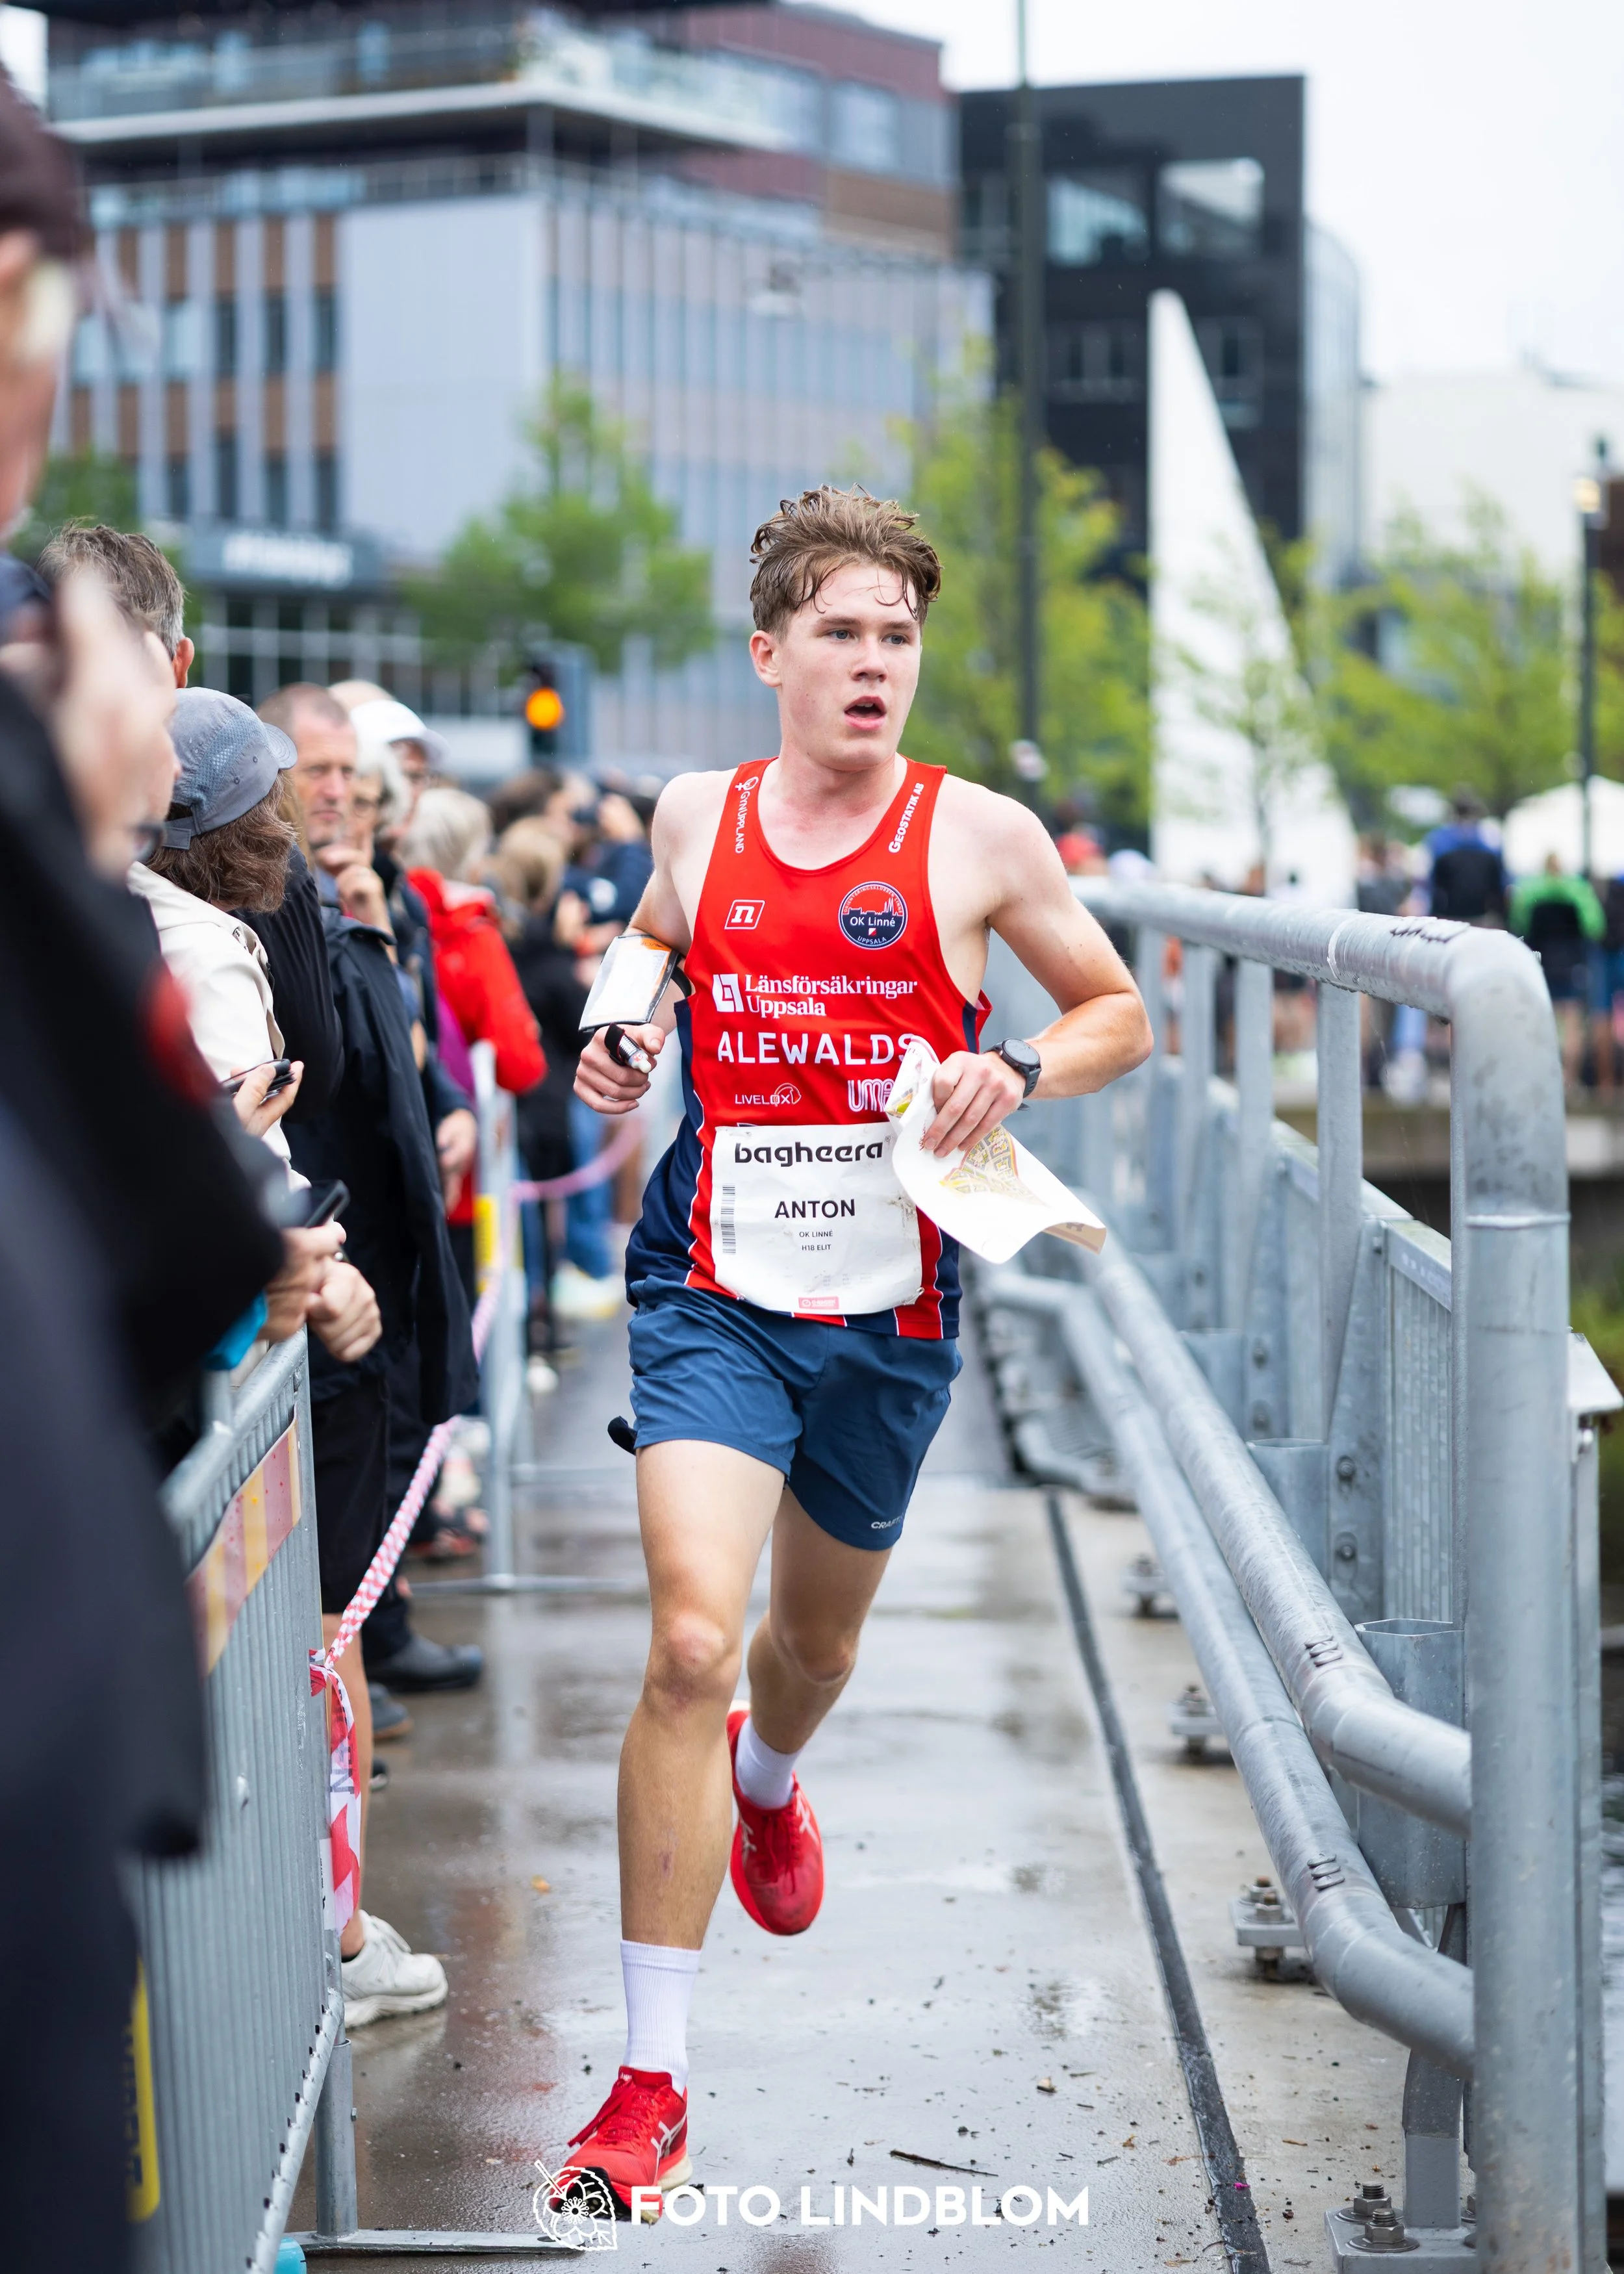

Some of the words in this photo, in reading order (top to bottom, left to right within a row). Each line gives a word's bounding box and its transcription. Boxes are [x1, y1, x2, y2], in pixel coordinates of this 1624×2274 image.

[888, 794, 919, 853] GEOSTATIK
[913, 782, 924, 795] AB
[850, 916, 865, 926] OK
[868, 917, 896, 927] Linné
[857, 936, 887, 945] UPPSALA
[745, 974, 918, 999] Länsförsäkringar
[746, 995, 826, 1019] Uppsala
[735, 1141, 883, 1168] bagheera
[774, 1199, 856, 1218] ANTON
